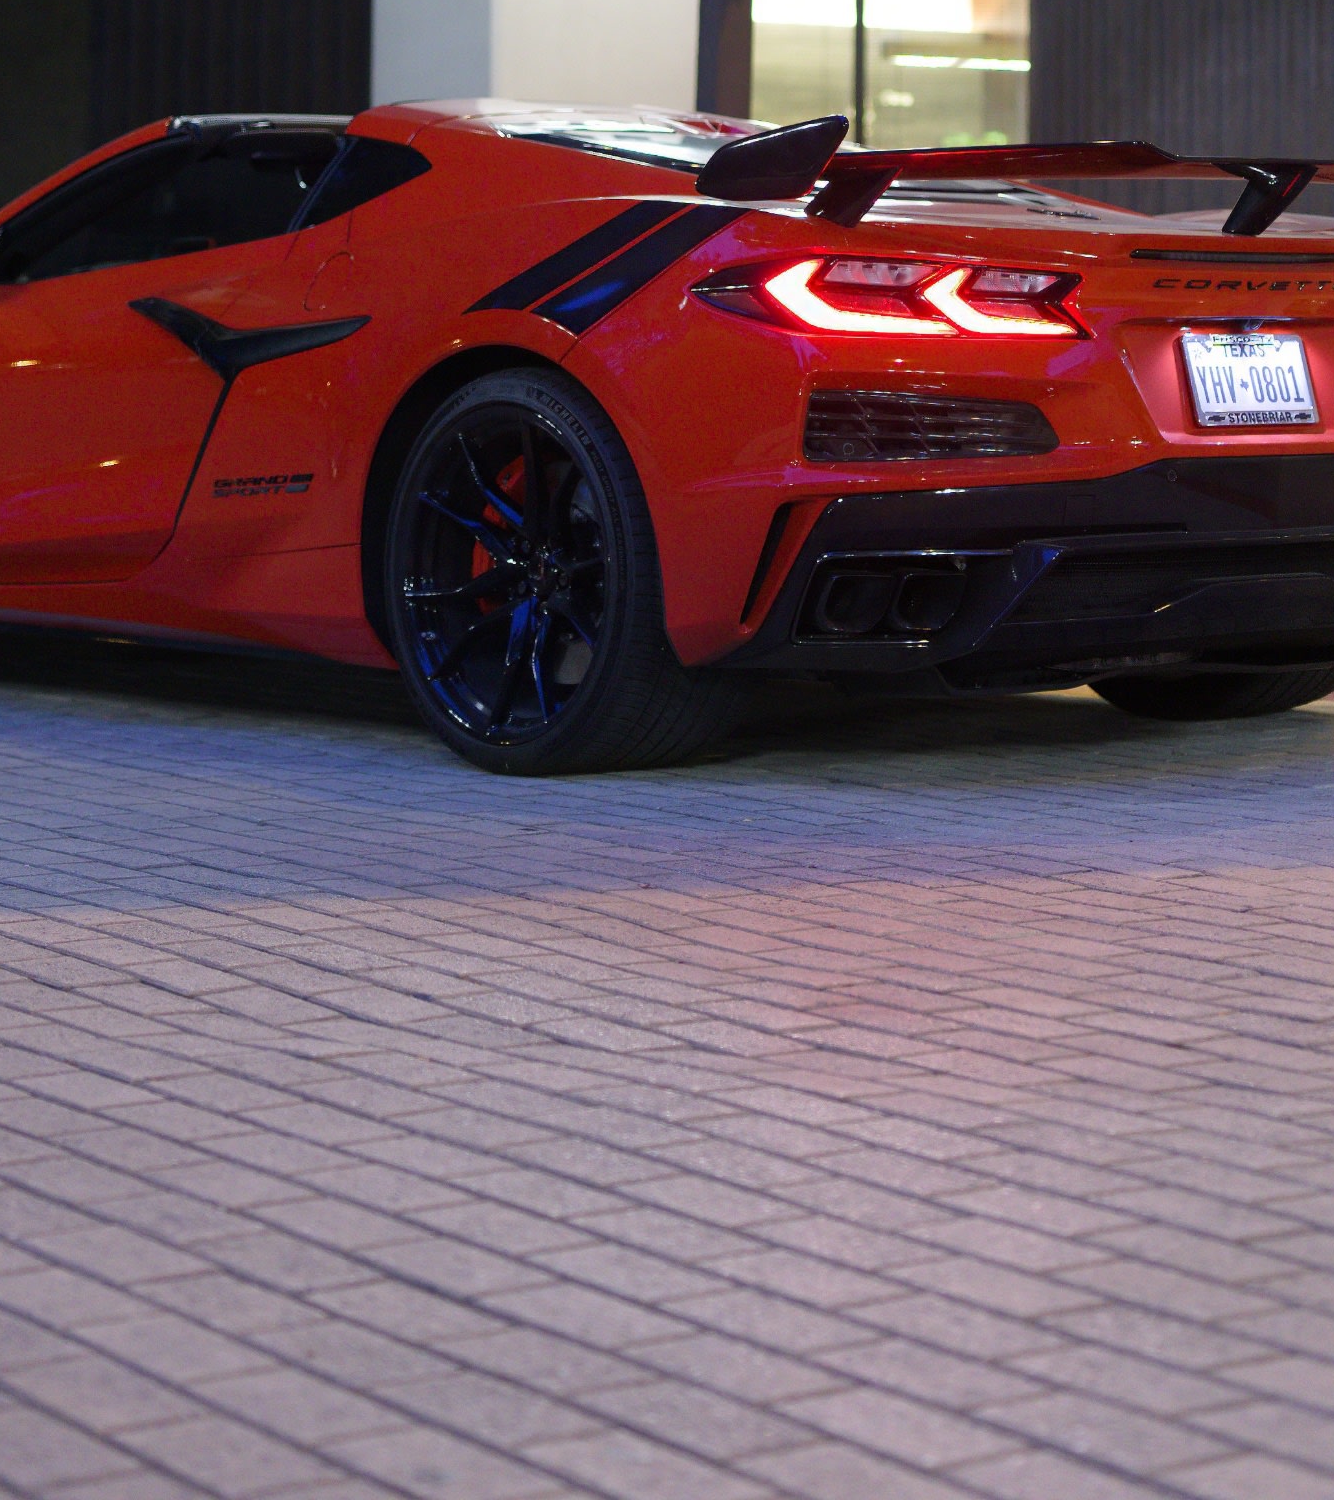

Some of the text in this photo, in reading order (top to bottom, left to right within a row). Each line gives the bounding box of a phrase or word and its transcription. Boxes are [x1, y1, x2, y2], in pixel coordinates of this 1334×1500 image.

[1222, 344, 1265, 358] TEXAS
[1196, 366, 1305, 404] YHV 0801
[538, 393, 592, 446] MICHELIN
[1227, 412, 1294, 424] STONEBRIAR
